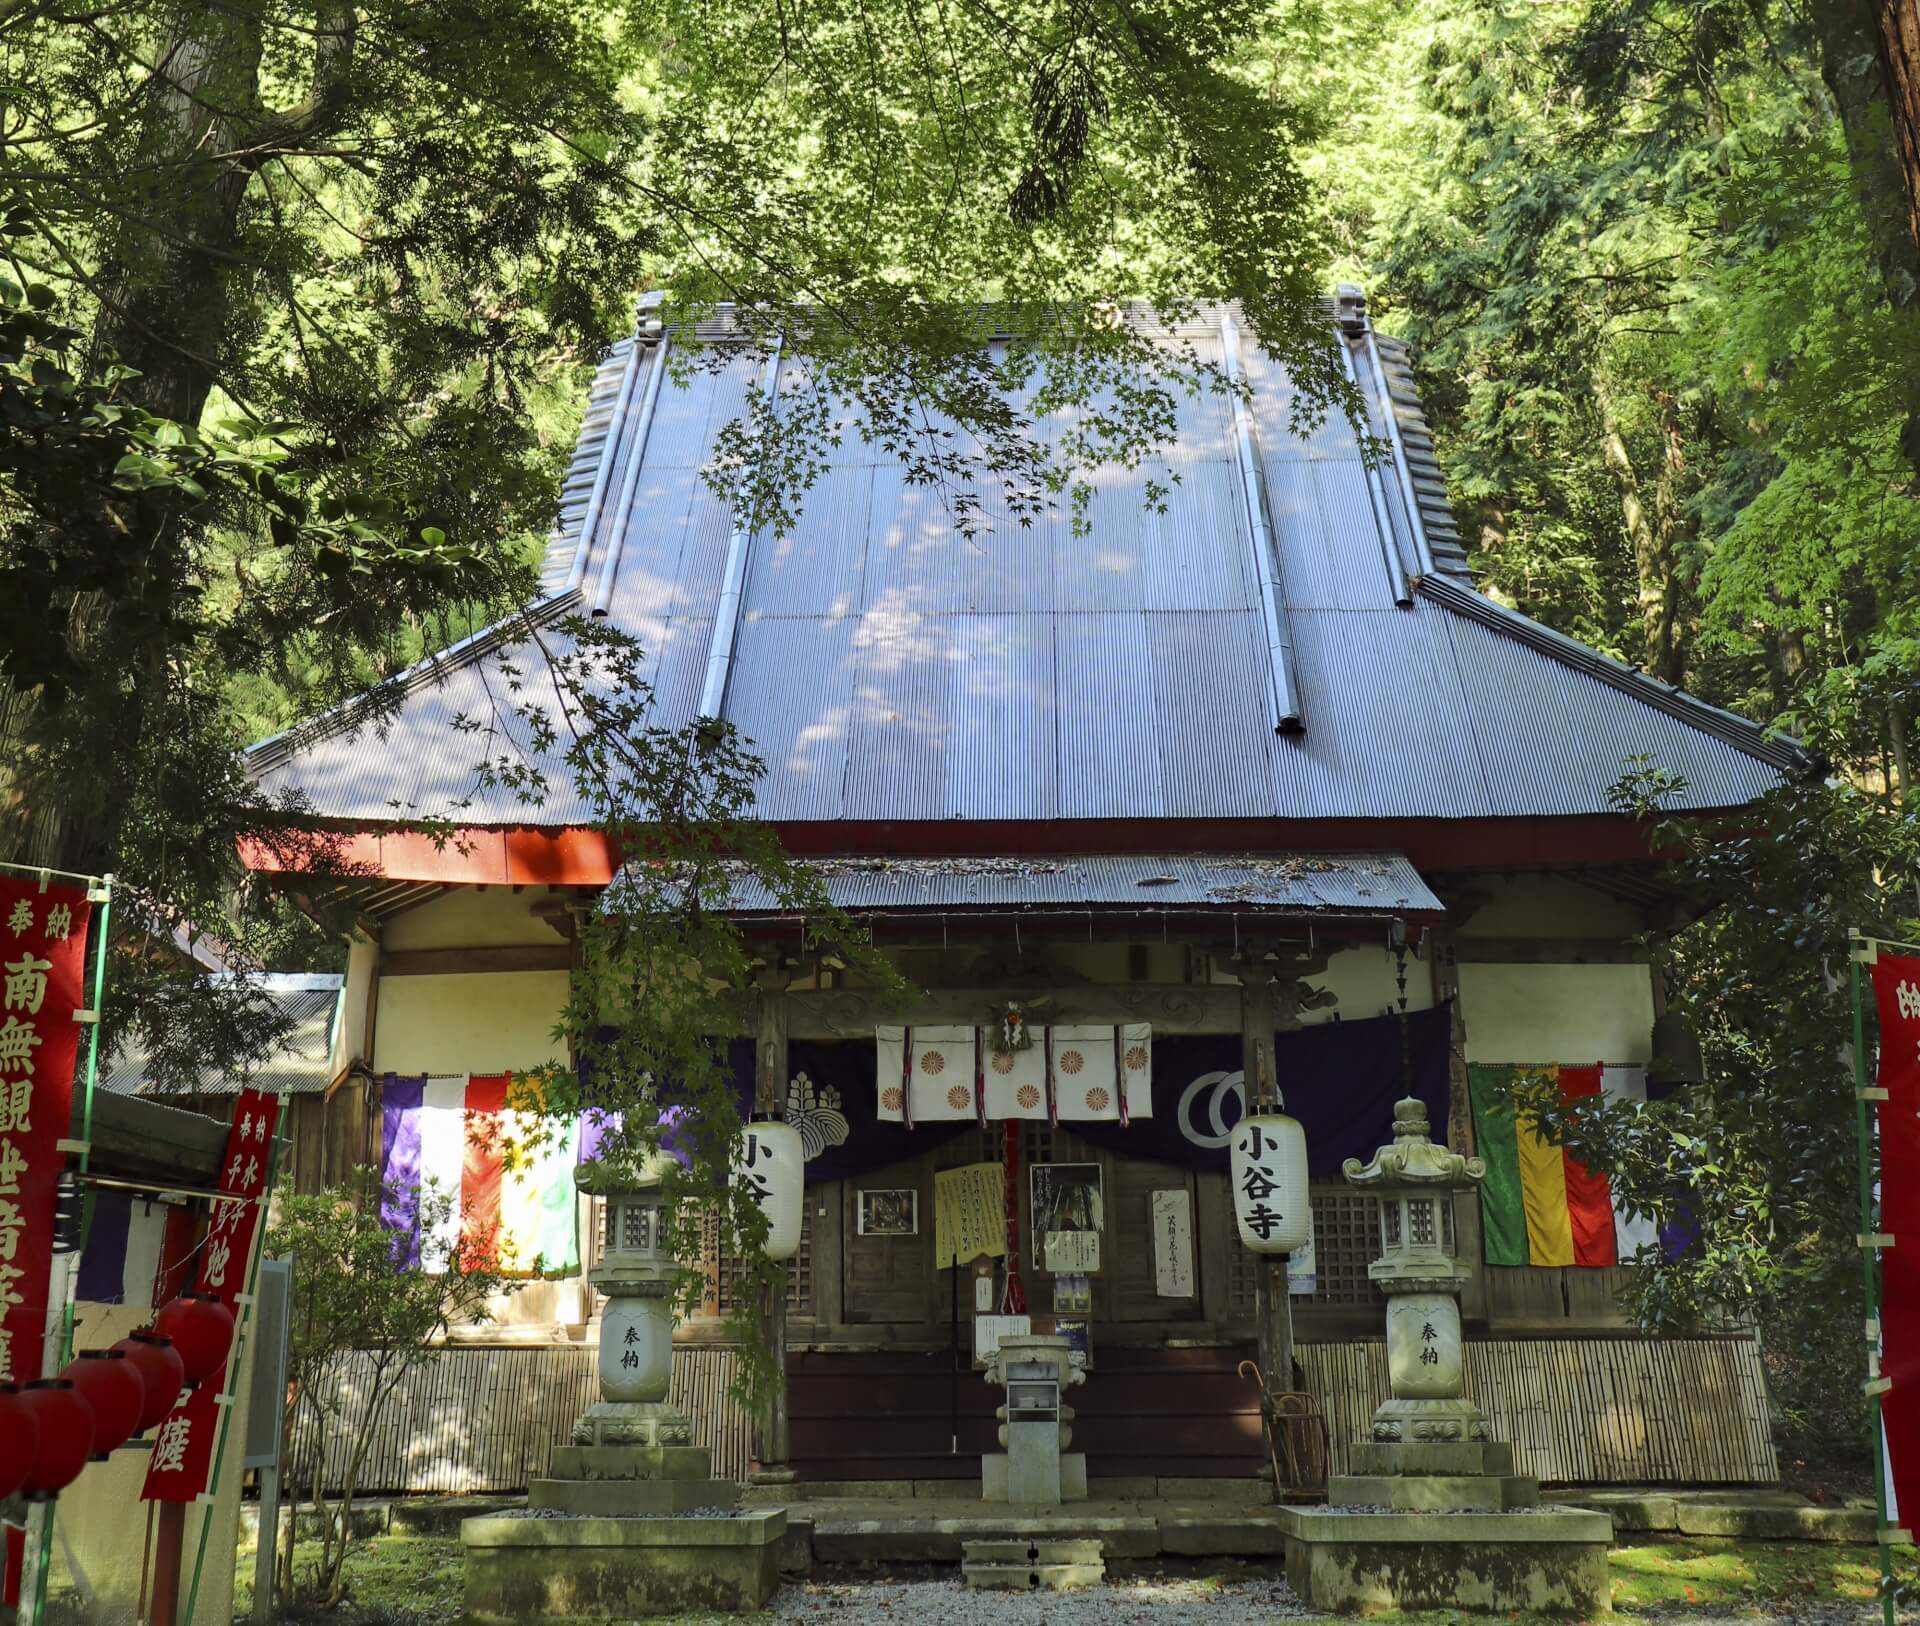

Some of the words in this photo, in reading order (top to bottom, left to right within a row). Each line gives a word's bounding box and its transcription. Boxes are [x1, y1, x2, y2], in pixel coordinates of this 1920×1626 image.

[7, 898, 72, 940] 奉納
[240, 1112, 267, 1144] 奉納
[1239, 1125, 1283, 1240] 小谷寺
[620, 1325, 641, 1369] 奉納
[1419, 1322, 1438, 1366] 奉納
